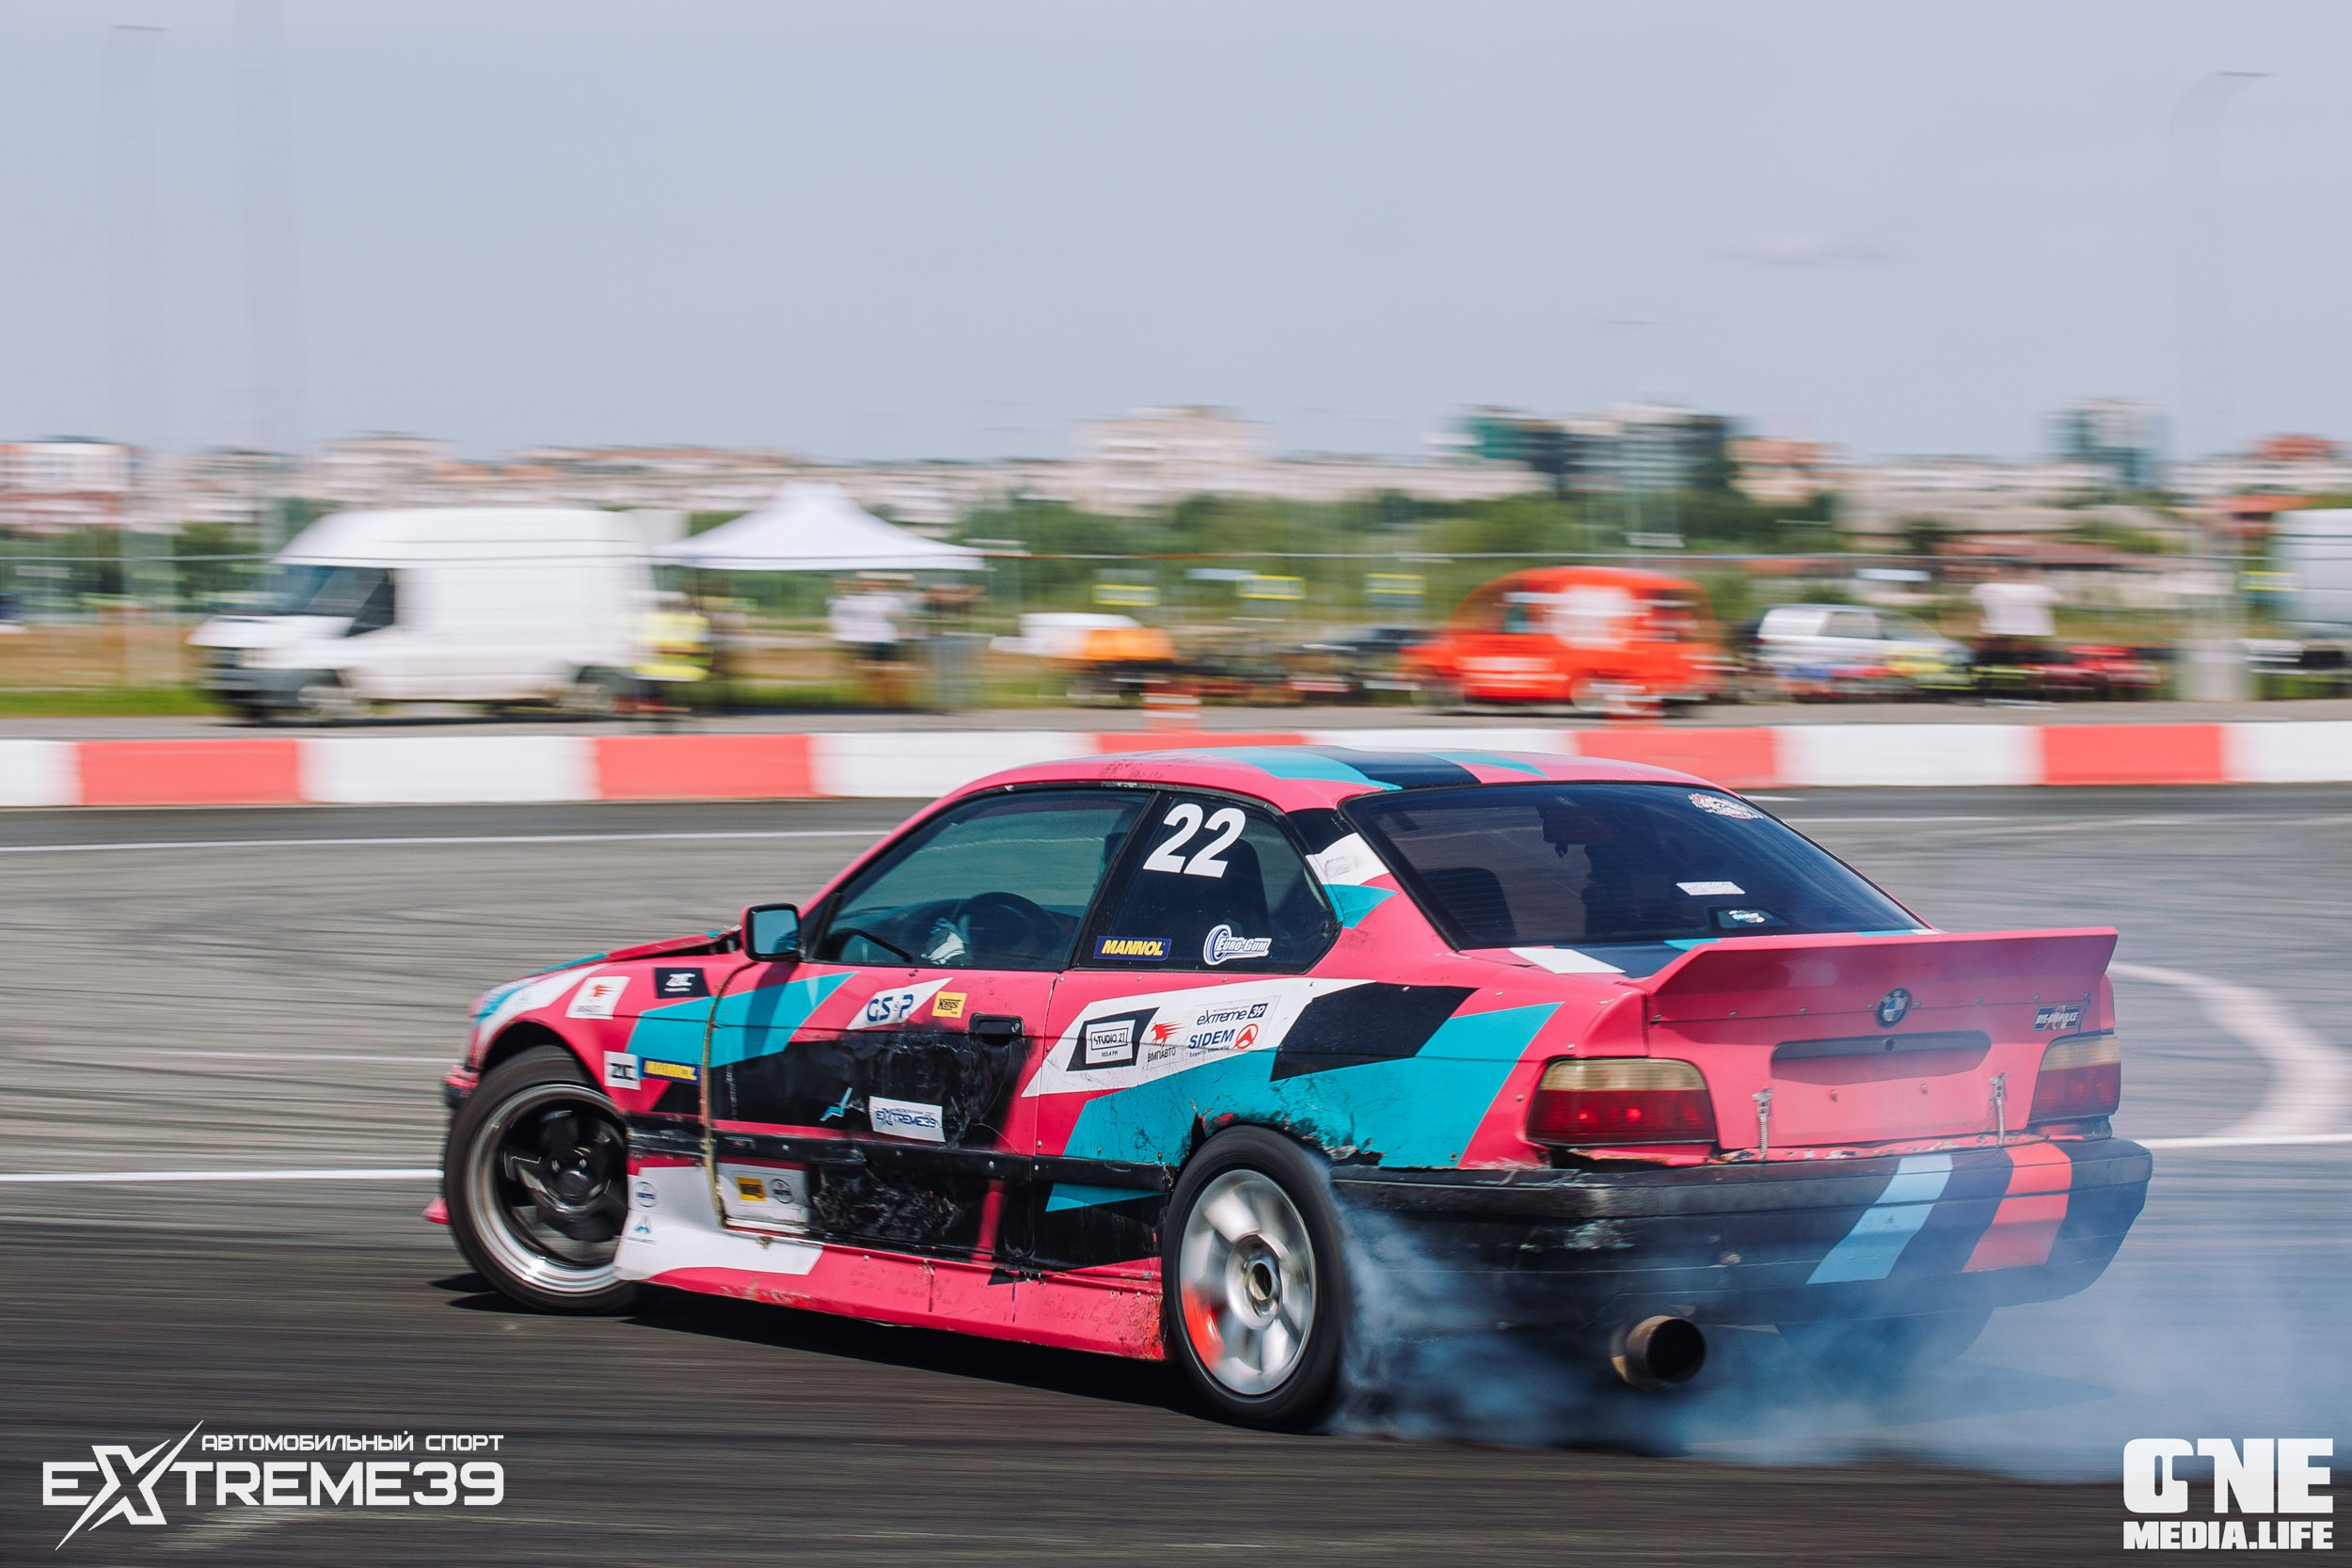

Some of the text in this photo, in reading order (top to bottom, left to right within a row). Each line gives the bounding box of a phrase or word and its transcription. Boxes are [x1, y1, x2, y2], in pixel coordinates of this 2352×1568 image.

[1143, 803, 1247, 879] 22
[1101, 940, 1165, 957] MANNOL
[1093, 1032, 1125, 1045] STUDIO 21
[1188, 1028, 1236, 1049] SIDEM
